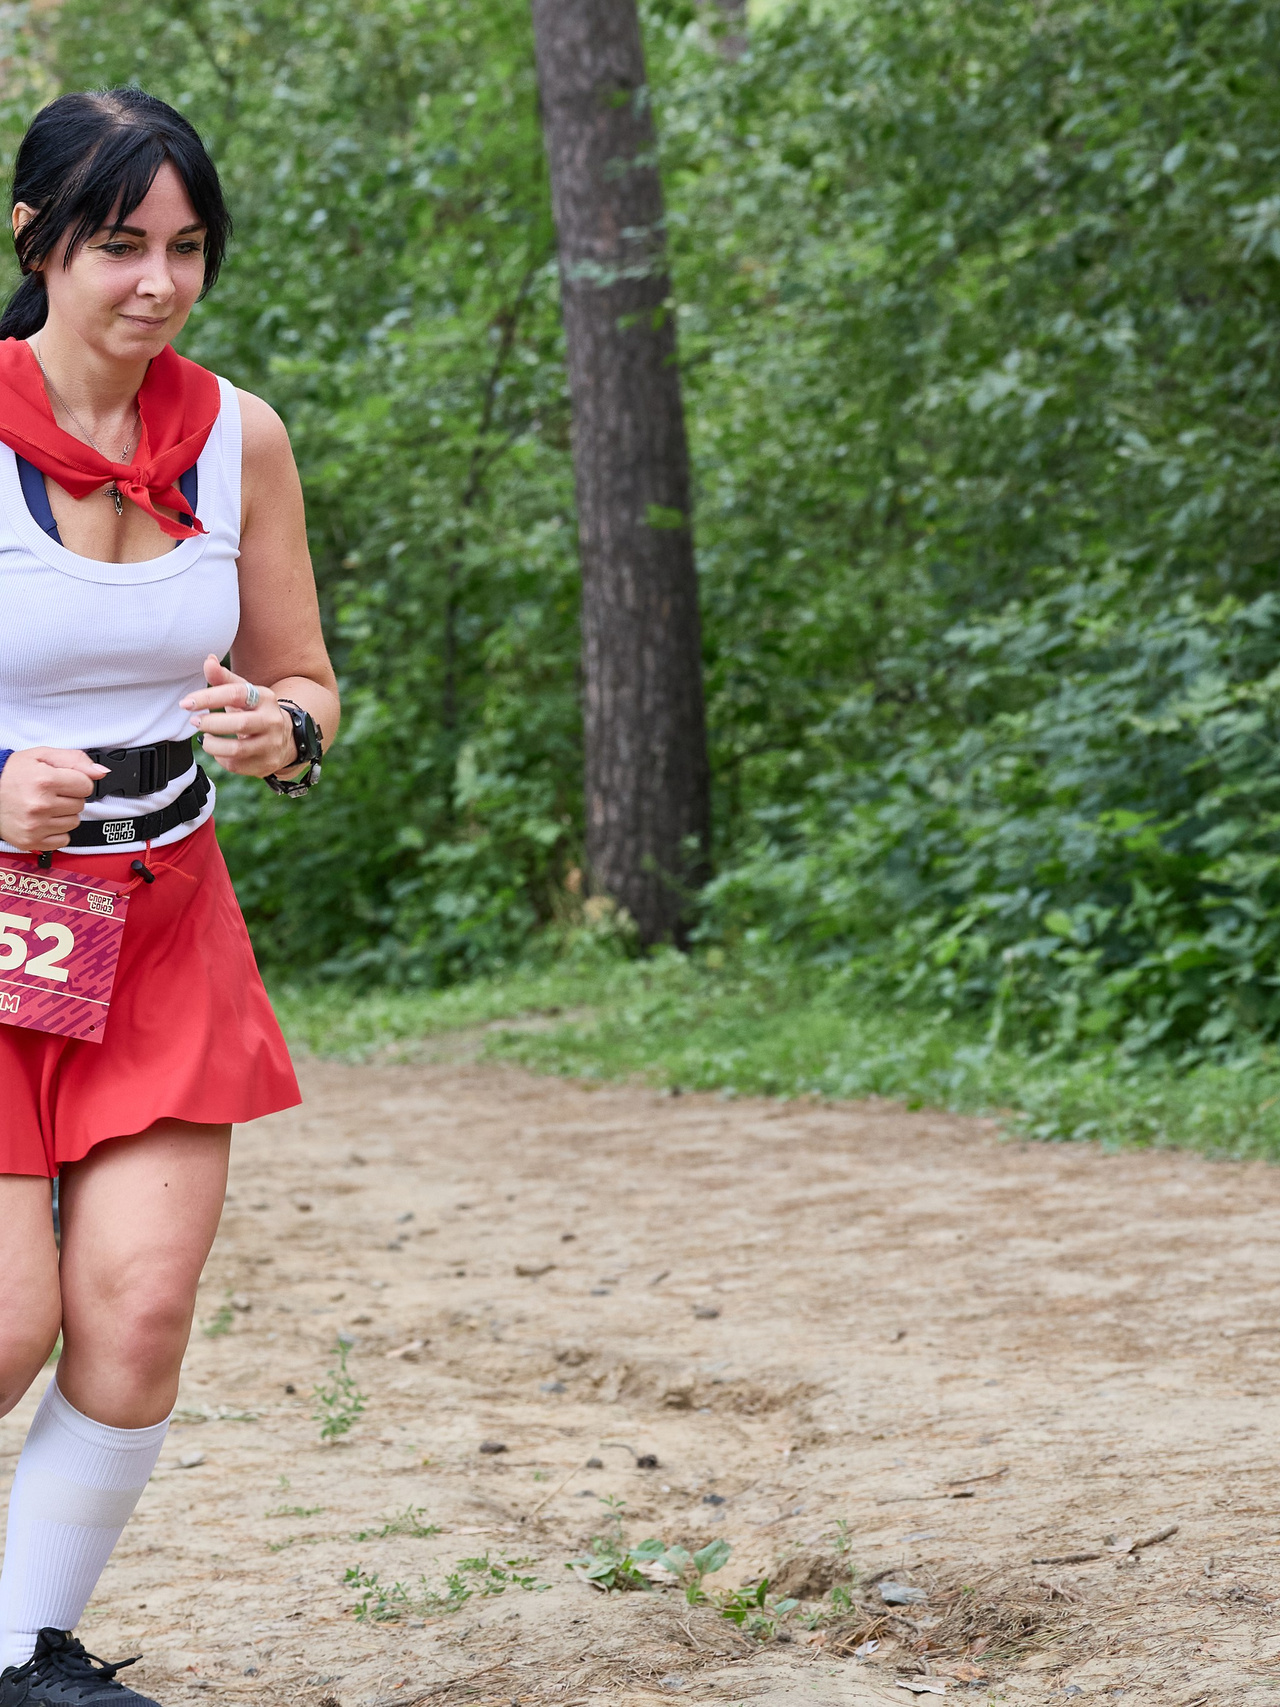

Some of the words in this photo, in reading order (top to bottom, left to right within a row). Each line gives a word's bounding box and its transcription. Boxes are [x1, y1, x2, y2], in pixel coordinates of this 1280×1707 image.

[108, 830, 134, 841] СОЮЗ
[0, 883, 66, 902] физкультурника
[19, 875, 68, 897] КРОСС
[91, 902, 113, 913] СОЮЗ
